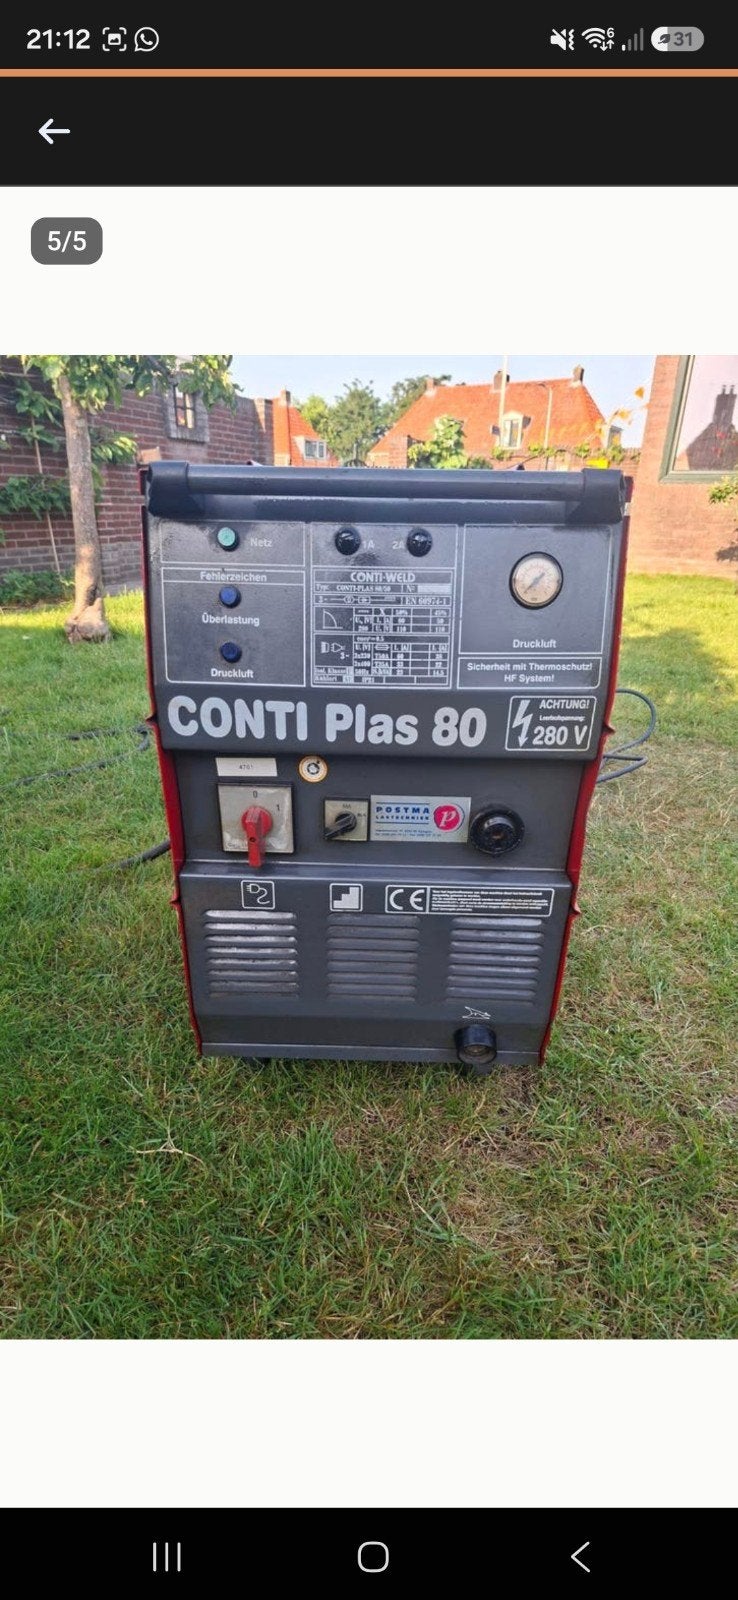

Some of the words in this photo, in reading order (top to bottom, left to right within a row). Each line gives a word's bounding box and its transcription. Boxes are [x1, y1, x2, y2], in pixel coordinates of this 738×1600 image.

[250, 538, 273, 548] Netz
[362, 540, 375, 549] 1A
[392, 541, 405, 550] 2A
[200, 571, 267, 582] Fehlerzeichen
[350, 572, 416, 583] CONTI-WELD
[202, 612, 260, 627] Überlastung
[512, 639, 557, 649] Druckluft
[467, 662, 511, 671] Sicherheit
[512, 662, 527, 671] mit
[529, 662, 593, 671] Thermoschutz!
[210, 668, 254, 679] Druckluft
[504, 674, 517, 682] HF
[519, 674, 555, 684] System!
[539, 699, 590, 709] ACHTUNG!
[167, 695, 308, 741] CONTI
[325, 703, 419, 746] Plas
[432, 706, 488, 748] 80
[532, 725, 569, 746] 280
[574, 725, 588, 746] V
[252, 790, 258, 799] 0
[376, 806, 430, 814] POSTMA
[389, 888, 425, 911] CE
